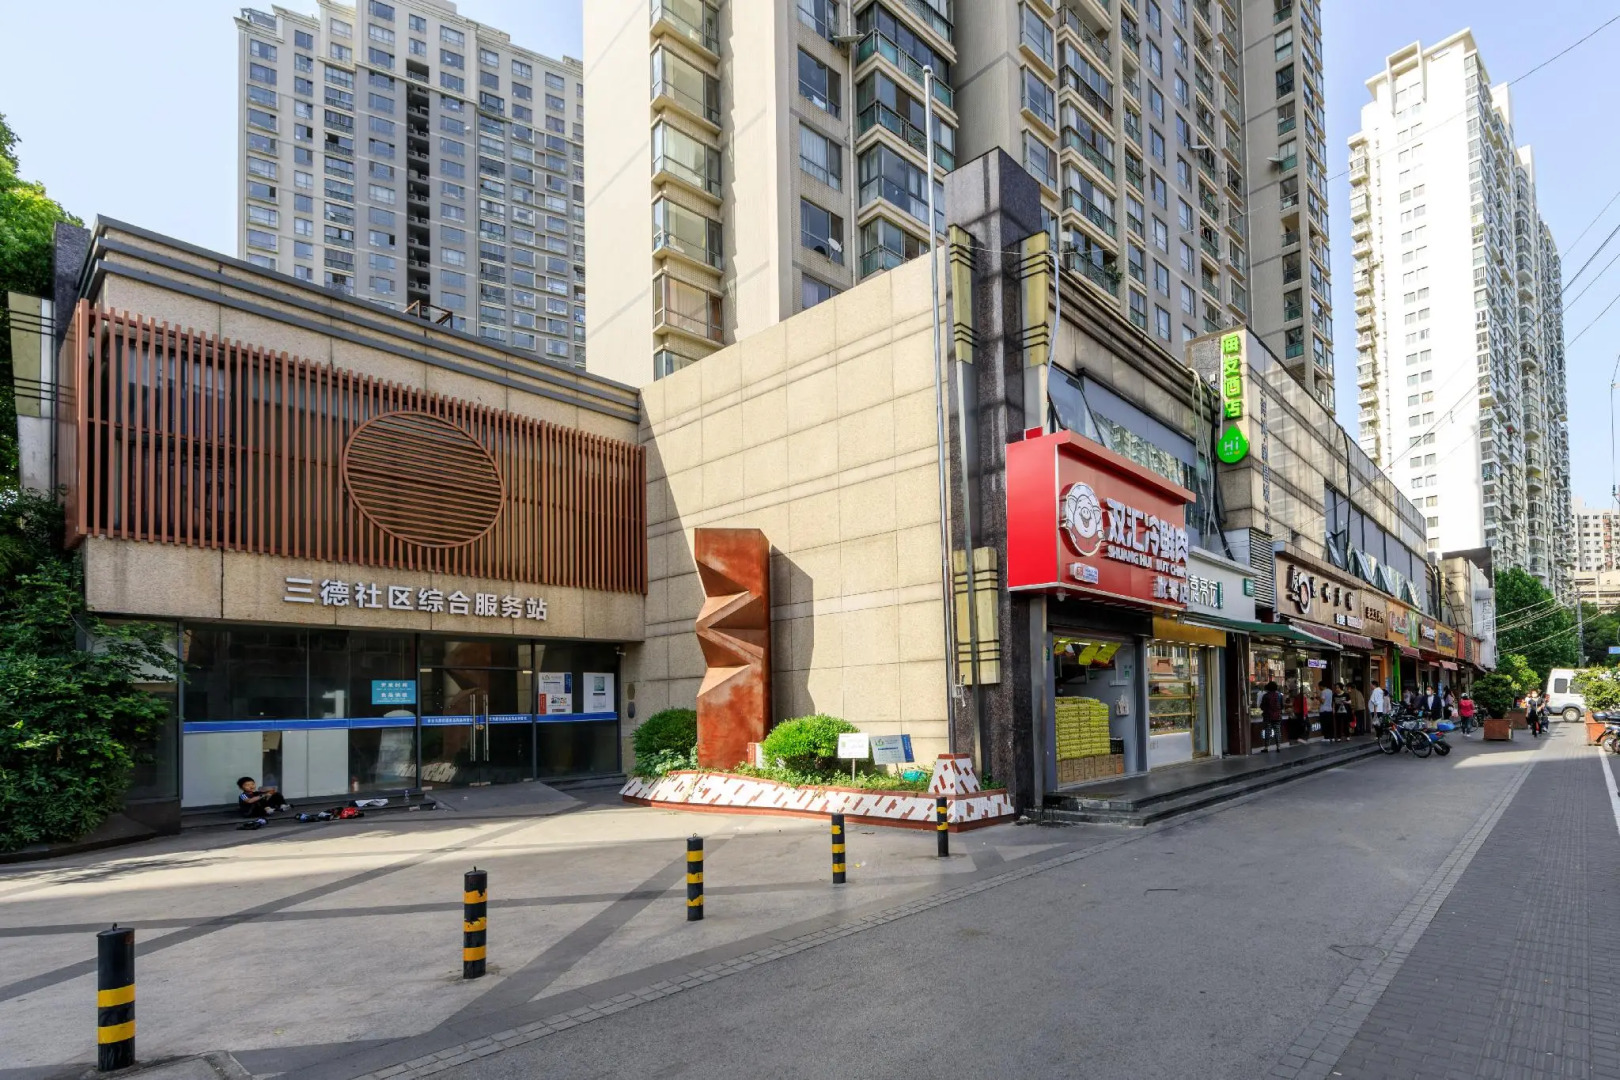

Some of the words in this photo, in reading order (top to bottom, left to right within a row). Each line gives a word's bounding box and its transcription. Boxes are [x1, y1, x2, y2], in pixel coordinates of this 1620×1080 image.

[1223, 435, 1239, 451] Hi
[1106, 497, 1188, 564] 双汇冷鲜肉
[284, 577, 548, 621] 三德社区综合服务站
